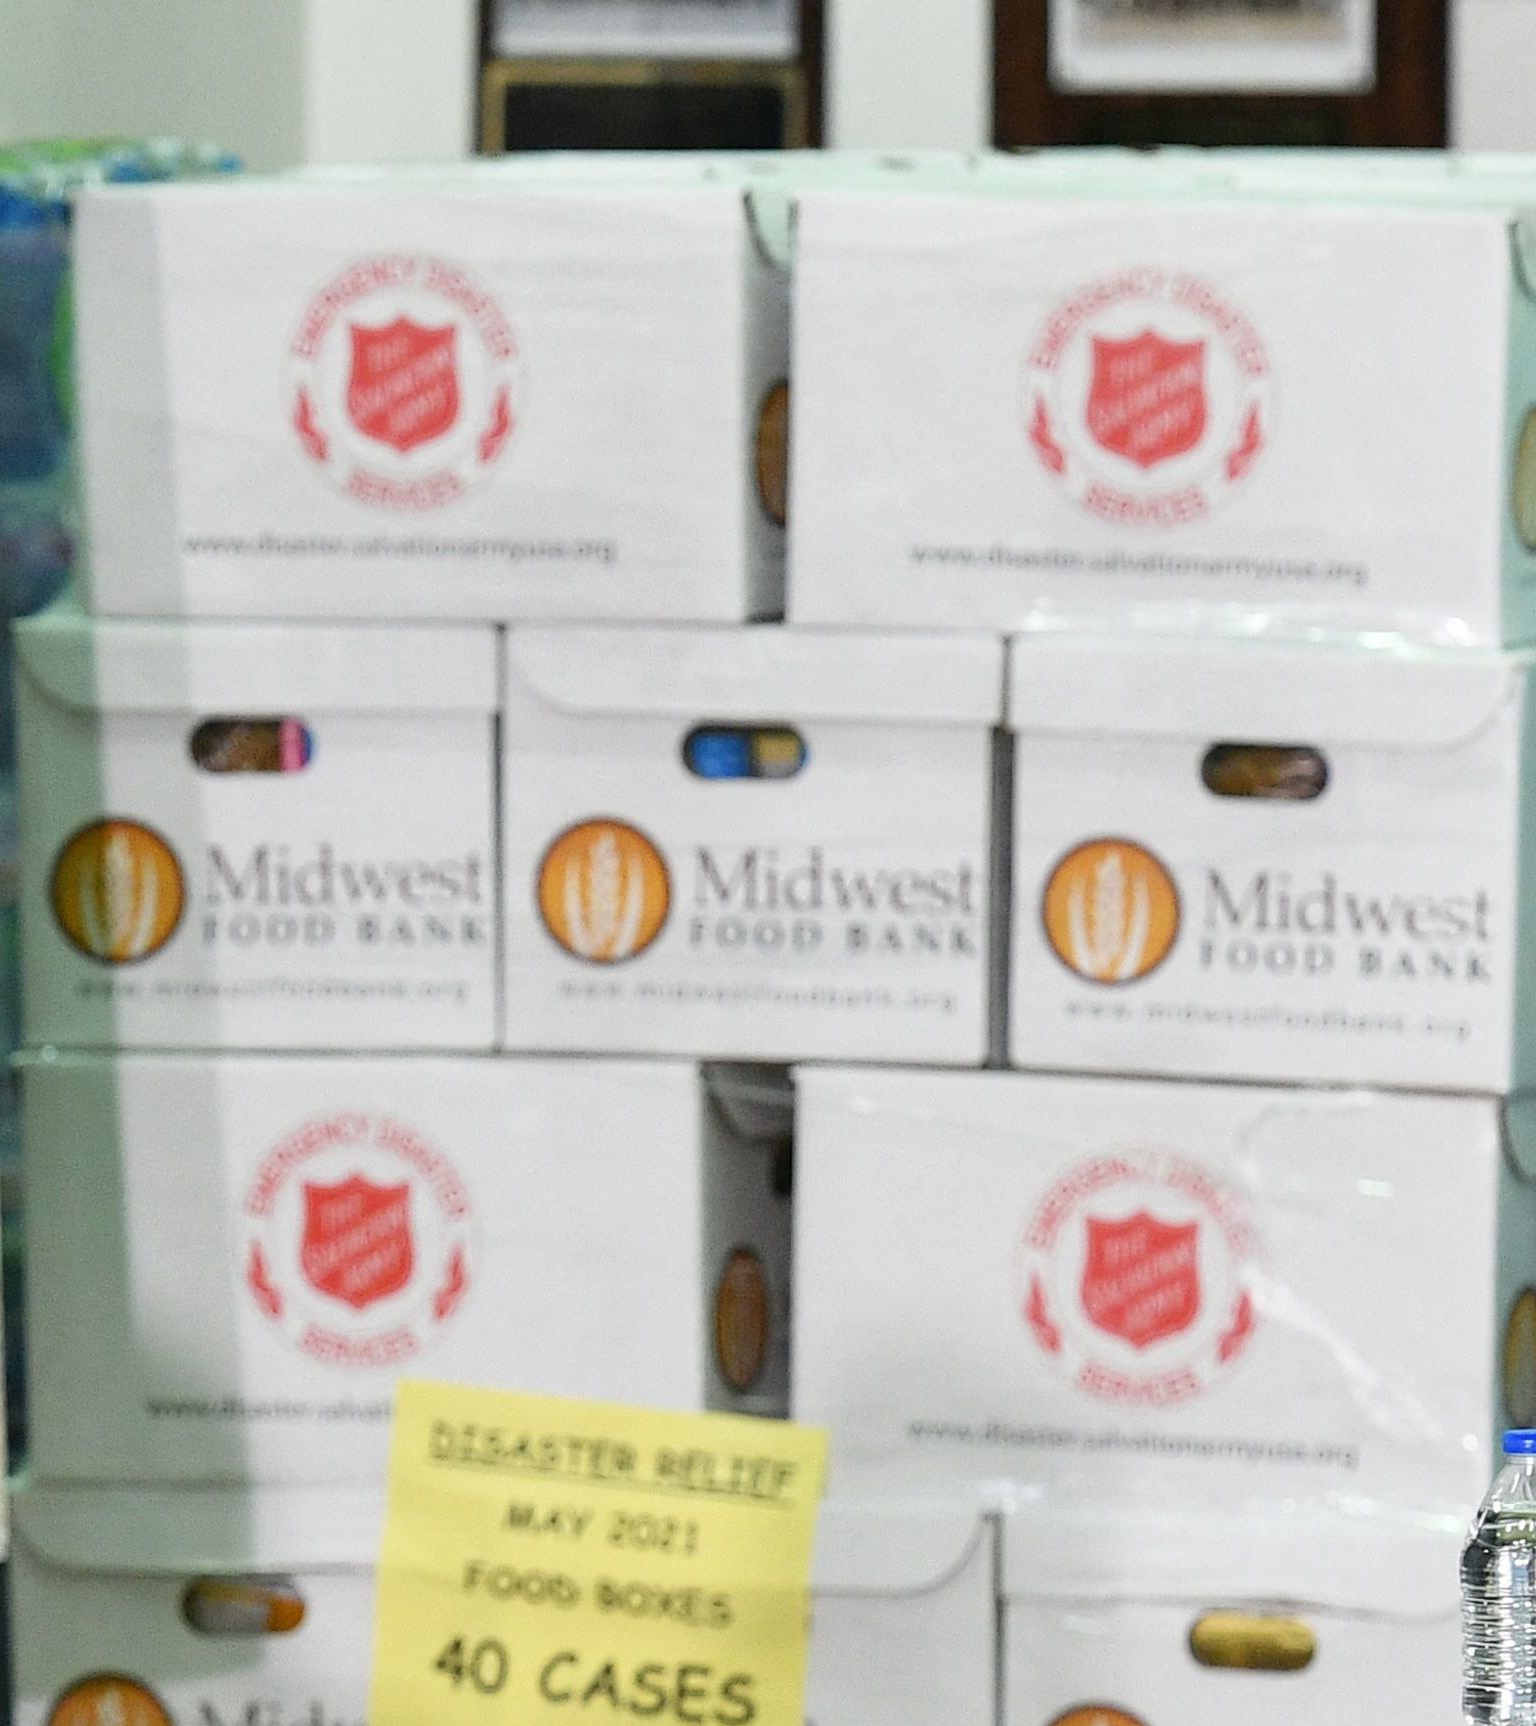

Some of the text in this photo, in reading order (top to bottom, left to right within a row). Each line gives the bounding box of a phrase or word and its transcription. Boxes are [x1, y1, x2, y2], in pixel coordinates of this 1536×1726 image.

[205, 840, 482, 908] Midwest
[694, 844, 973, 917] Midwest
[1202, 866, 1491, 944] Midwest
[201, 911, 487, 947] FOOD BANK
[688, 913, 979, 956] FOOD BANK
[1198, 937, 1492, 986] FOOD BANK
[429, 1419, 797, 1497] DISASTER RELIEF
[504, 1503, 699, 1556] MAY 2021
[463, 1560, 734, 1628] FOOD BOXES
[433, 1636, 510, 1694] 40
